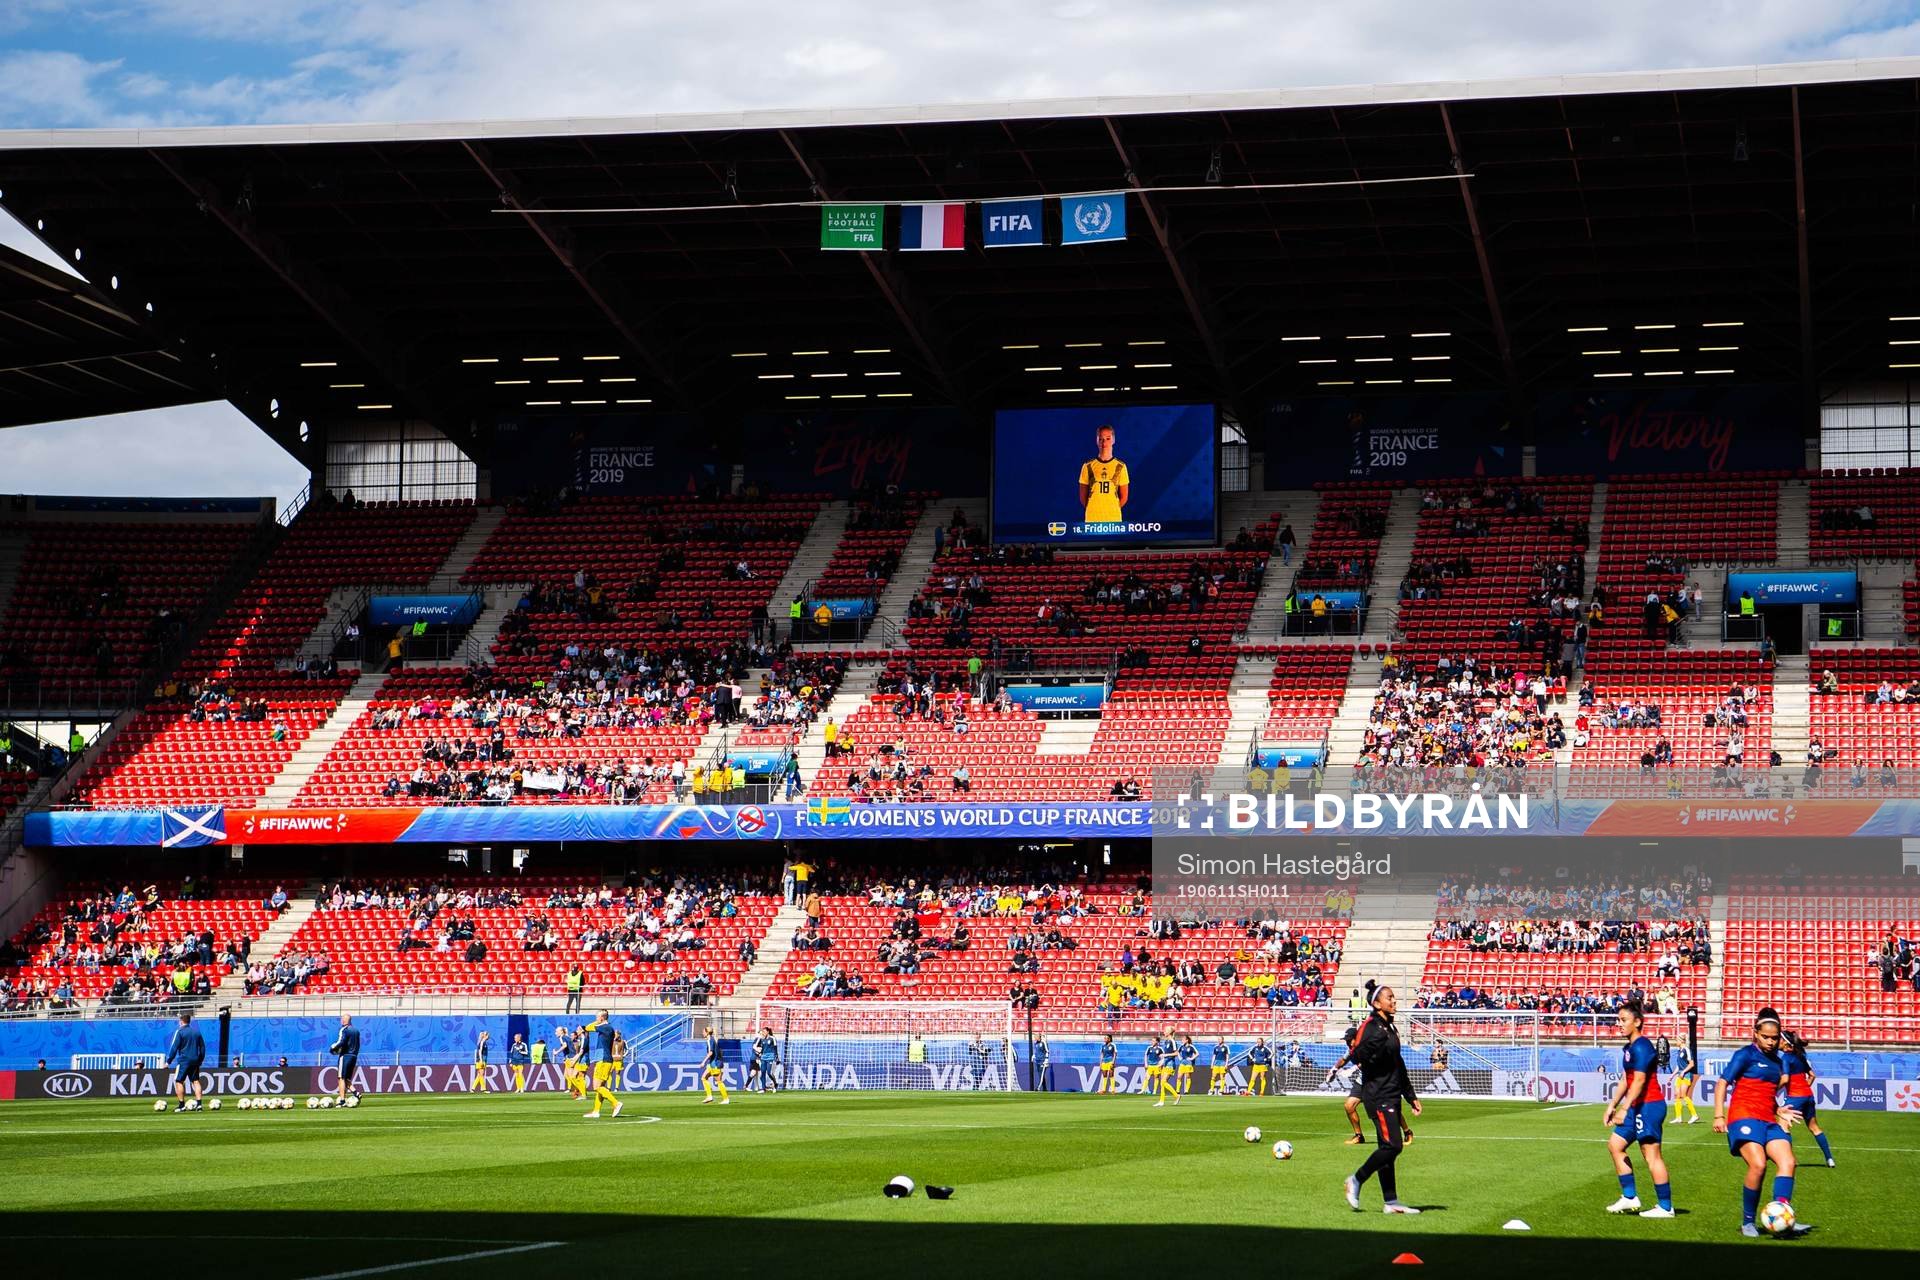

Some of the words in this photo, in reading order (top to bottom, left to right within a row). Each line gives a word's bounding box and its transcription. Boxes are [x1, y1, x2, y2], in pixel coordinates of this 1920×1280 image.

[828, 219, 875, 227] FOOTBALL
[990, 215, 1032, 231] FIFA
[854, 234, 874, 242] FIFA
[1369, 434, 1439, 450] FRANCE
[590, 452, 654, 468] FRANCE
[1370, 451, 1407, 467] 2019
[590, 468, 624, 484] 2019
[1098, 481, 1110, 494] 18
[1073, 526, 1083, 534] 18.
[1084, 523, 1126, 533] Fridolina
[1128, 522, 1161, 532] ROLFO
[1767, 584, 1818, 593] #FIFAWWC
[403, 606, 448, 615] #FIFAWWC
[1035, 696, 1078, 705] #FIFAWWC
[941, 809, 1013, 827] WORLD
[1019, 808, 1059, 826] CUP
[1064, 808, 1143, 826] FRANCE
[1696, 807, 1779, 822] #FIFAWWC
[259, 816, 333, 831] #FIFAWWC
[110, 1073, 157, 1095] KIA
[1604, 1072, 1623, 1081] TGV
[52, 1077, 83, 1092] KIA
[1851, 1087, 1884, 1096] Intérim
[1635, 1113, 1644, 1130] 5
